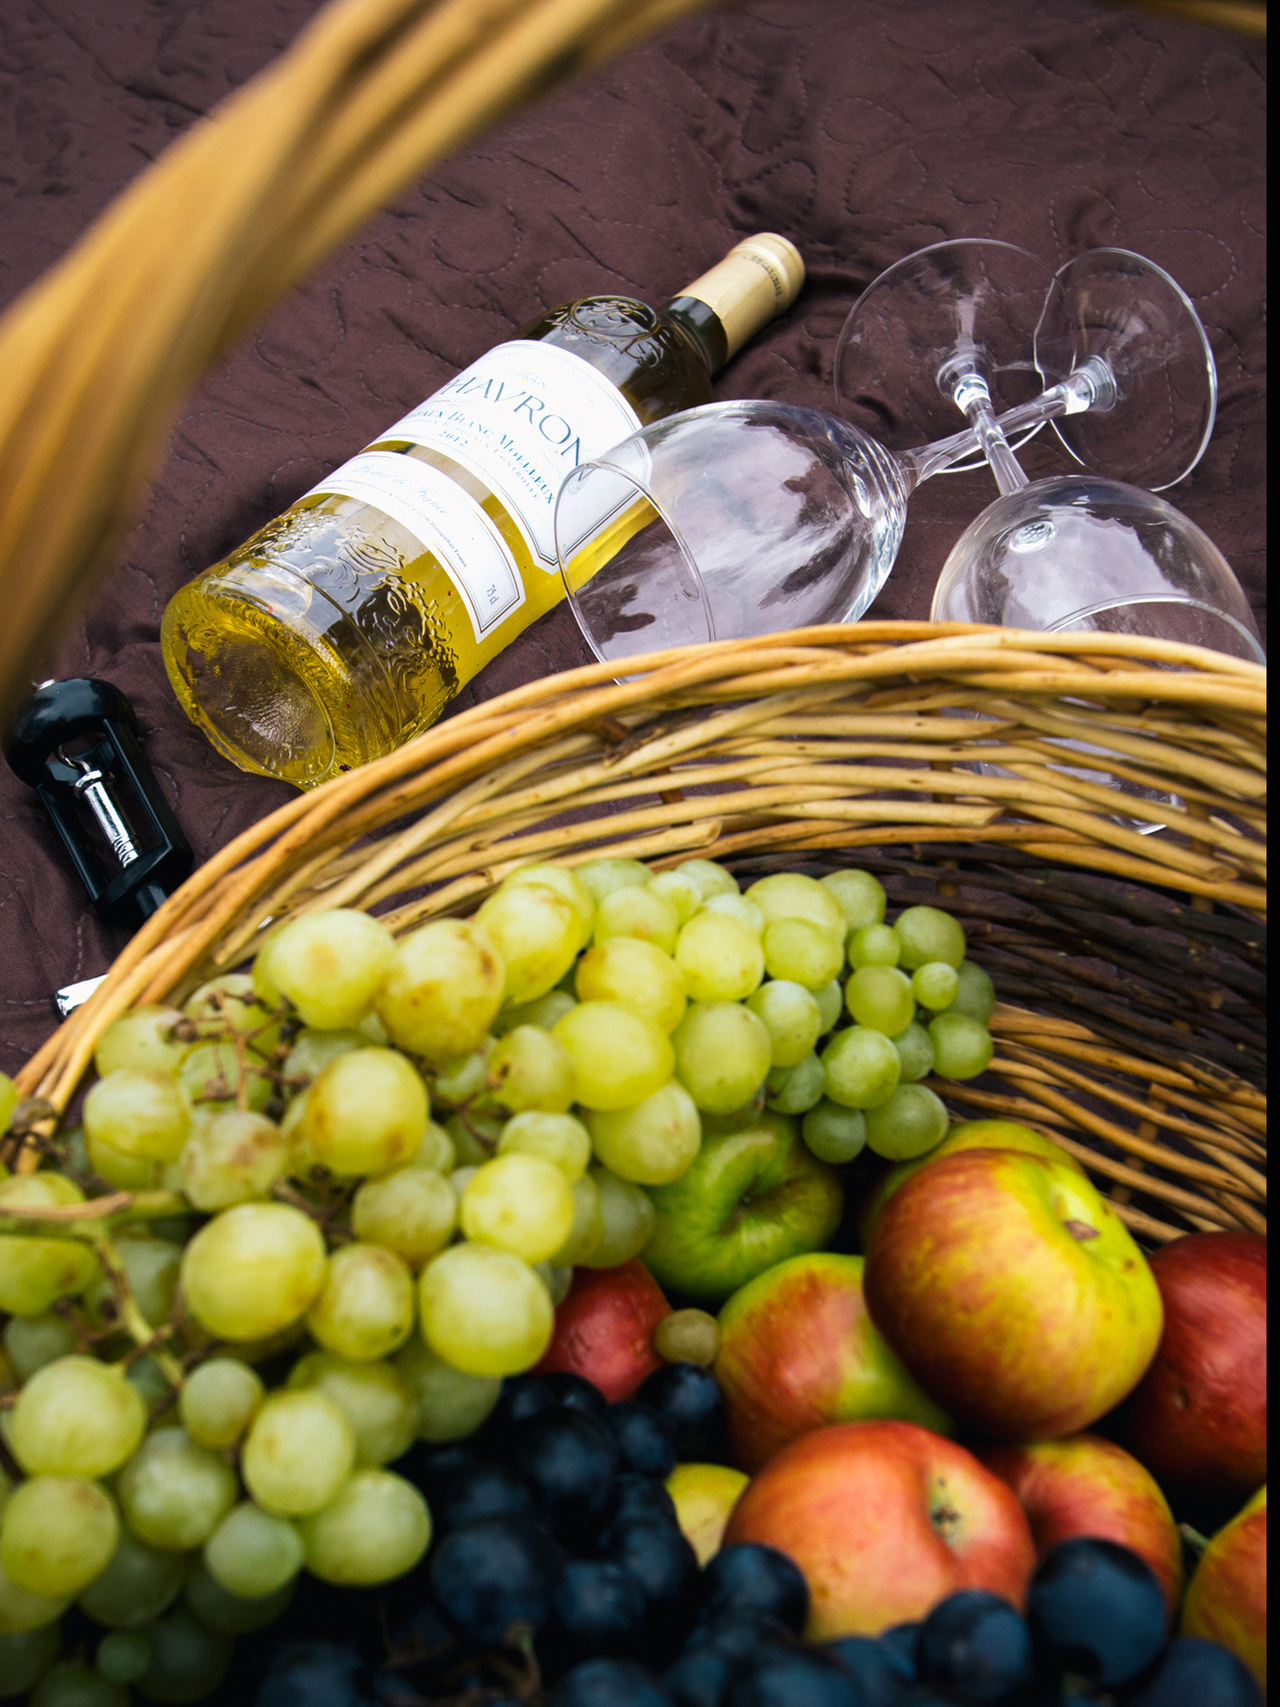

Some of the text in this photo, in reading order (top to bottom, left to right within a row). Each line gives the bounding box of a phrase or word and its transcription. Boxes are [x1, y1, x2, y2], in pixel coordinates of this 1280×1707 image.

[437, 430, 469, 447] 2012
[440, 375, 597, 483] HAVRON
[497, 433, 555, 504] MOELLEUX
